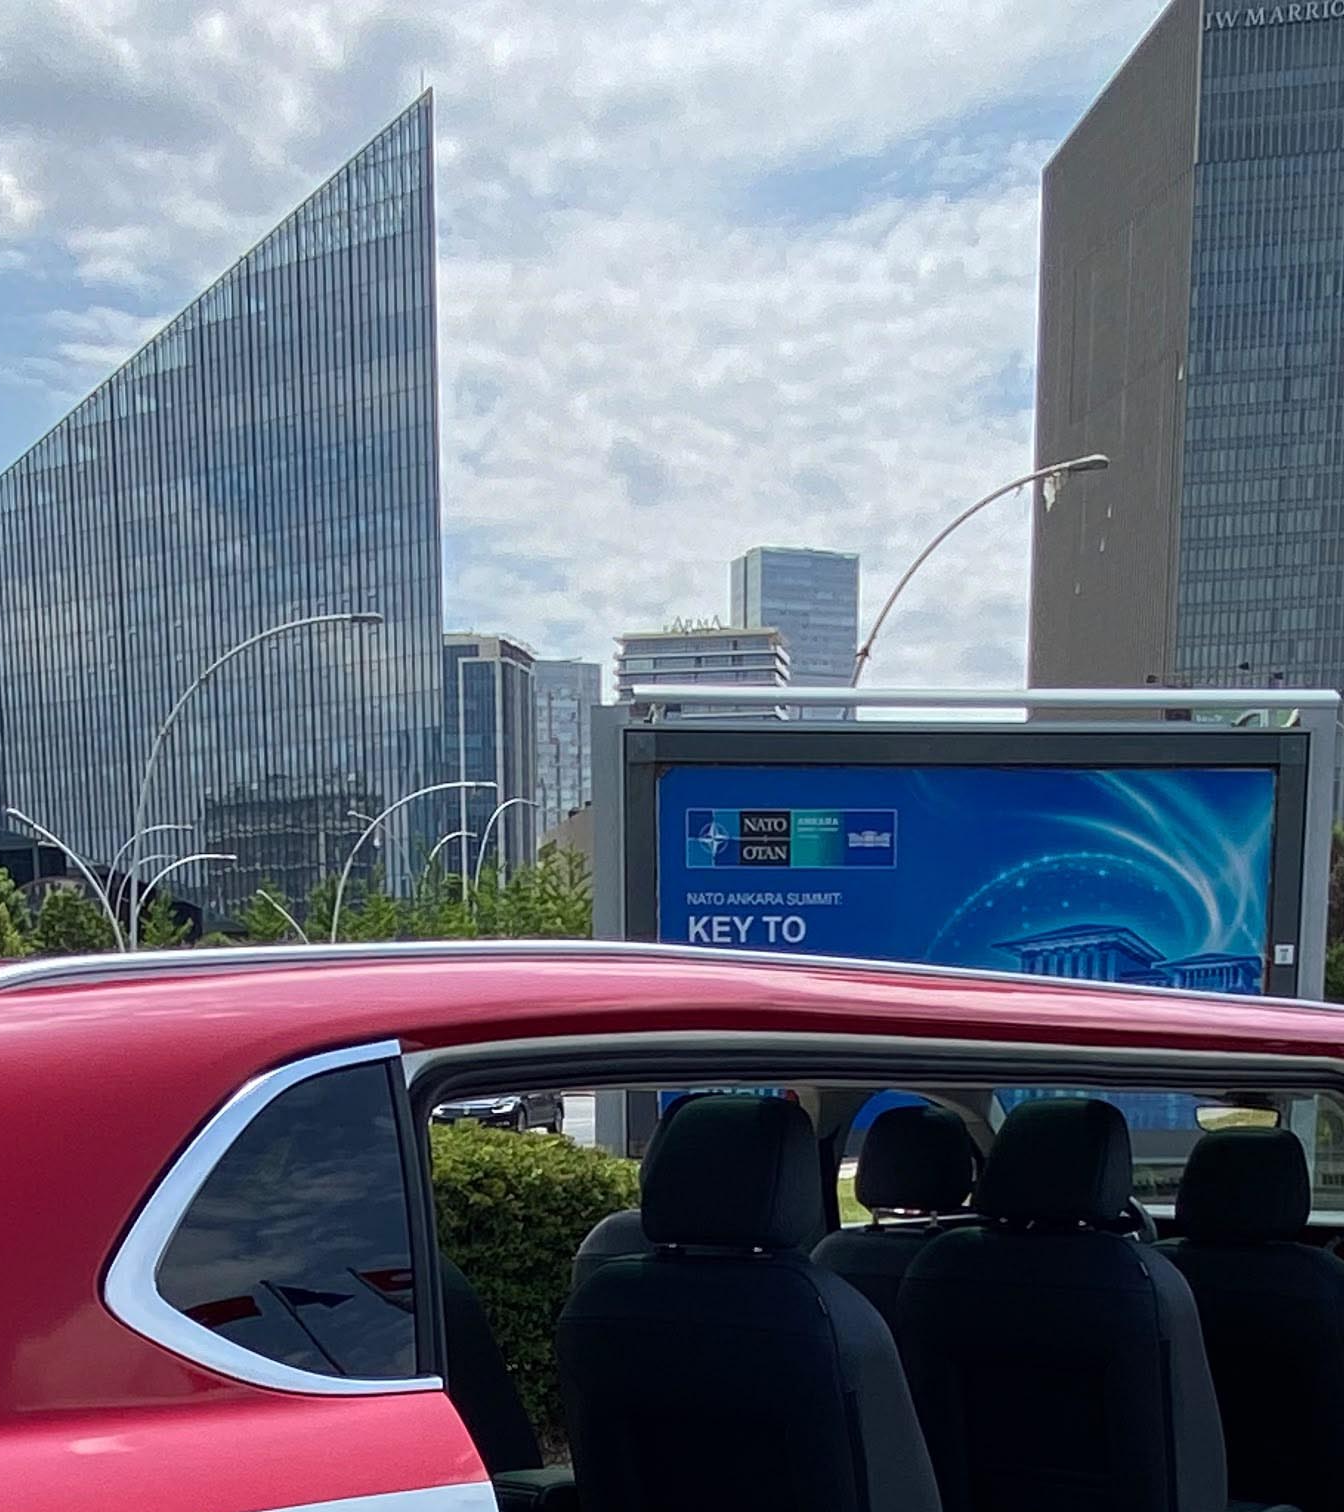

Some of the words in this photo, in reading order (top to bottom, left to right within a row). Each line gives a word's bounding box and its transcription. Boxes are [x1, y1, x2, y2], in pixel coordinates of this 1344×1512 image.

[1206, 10, 1239, 30] JW
[743, 817, 787, 832] NATO
[742, 846, 787, 860] OTAN
[687, 892, 724, 905] NATO
[727, 892, 784, 905] ANKARA
[787, 892, 843, 905] SUMMIT:
[688, 916, 754, 943] KEY
[762, 916, 806, 943] TO
